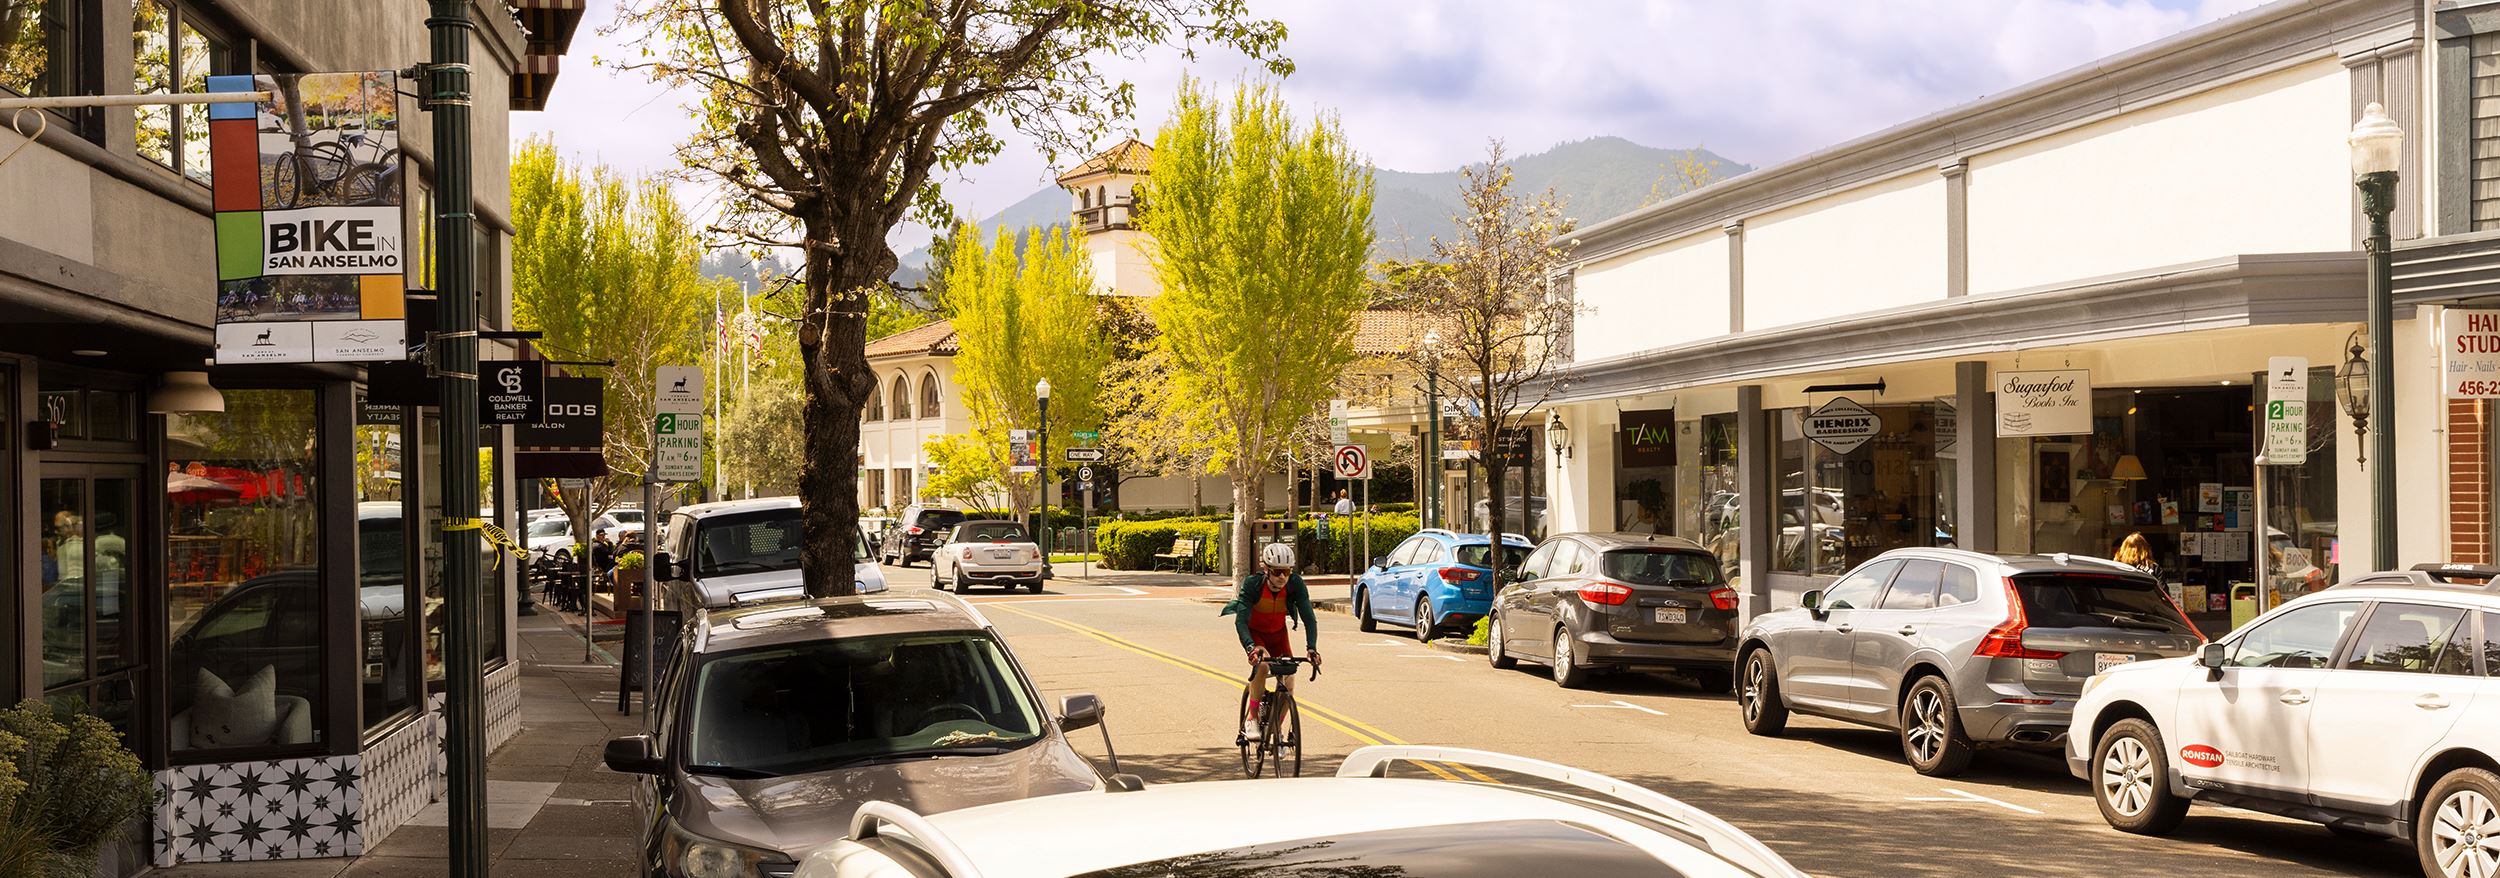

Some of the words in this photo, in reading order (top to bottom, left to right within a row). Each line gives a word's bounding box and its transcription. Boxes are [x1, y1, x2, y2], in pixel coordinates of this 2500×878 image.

[269, 220, 375, 254] BIKE
[377, 236, 396, 251] IN
[269, 256, 305, 269] SAN
[308, 255, 398, 268] ANSELMO
[2468, 314, 2498, 332] HAI
[2457, 335, 2500, 353] STUD
[2449, 361, 2468, 373] Hair
[2475, 361, 2496, 373] Nails
[2004, 376, 2074, 398] Sugarfoot
[2458, 381, 2500, 395] 456-2
[2022, 396, 2056, 408] Books
[2059, 395, 2079, 406] Inc
[47, 395, 66, 425] 562
[2272, 403, 2281, 418] 2
[2285, 406, 2303, 416] HOUR
[661, 416, 672, 432] 2
[677, 420, 699, 430] HOUR
[1813, 418, 1871, 428] HENRIX
[2271, 422, 2302, 432] PARKING
[660, 438, 698, 448] PARKING
[2182, 750, 2222, 762] RONSTAN
[2248, 753, 2276, 763] HARDWARE
[2245, 762, 2281, 772] ARCHITECTURE
